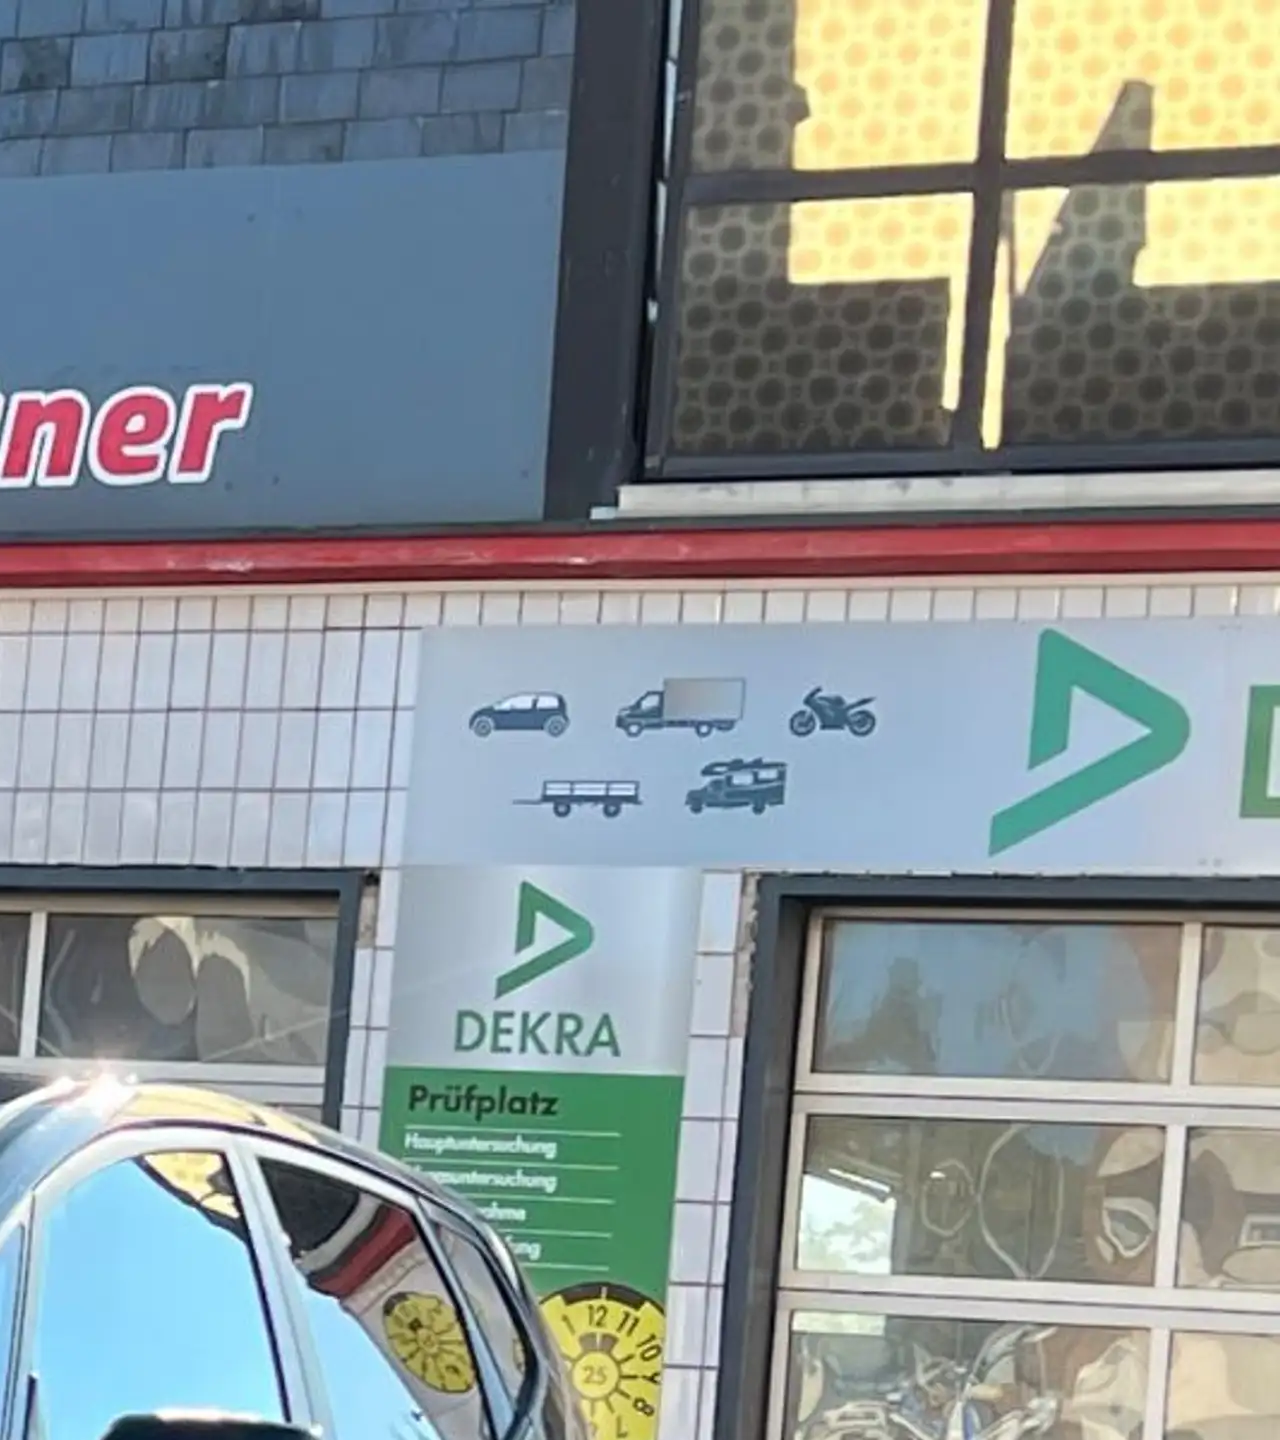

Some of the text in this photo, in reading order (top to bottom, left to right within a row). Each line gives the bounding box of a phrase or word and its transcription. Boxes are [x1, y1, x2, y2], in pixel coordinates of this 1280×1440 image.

[454, 1009, 621, 1057] DEKRA
[408, 1083, 559, 1122] Prüfplatz
[405, 1132, 557, 1160] Hauptuntersuchung
[587, 1303, 609, 1328] 12
[616, 1310, 640, 1338] 11
[636, 1334, 662, 1362] 10
